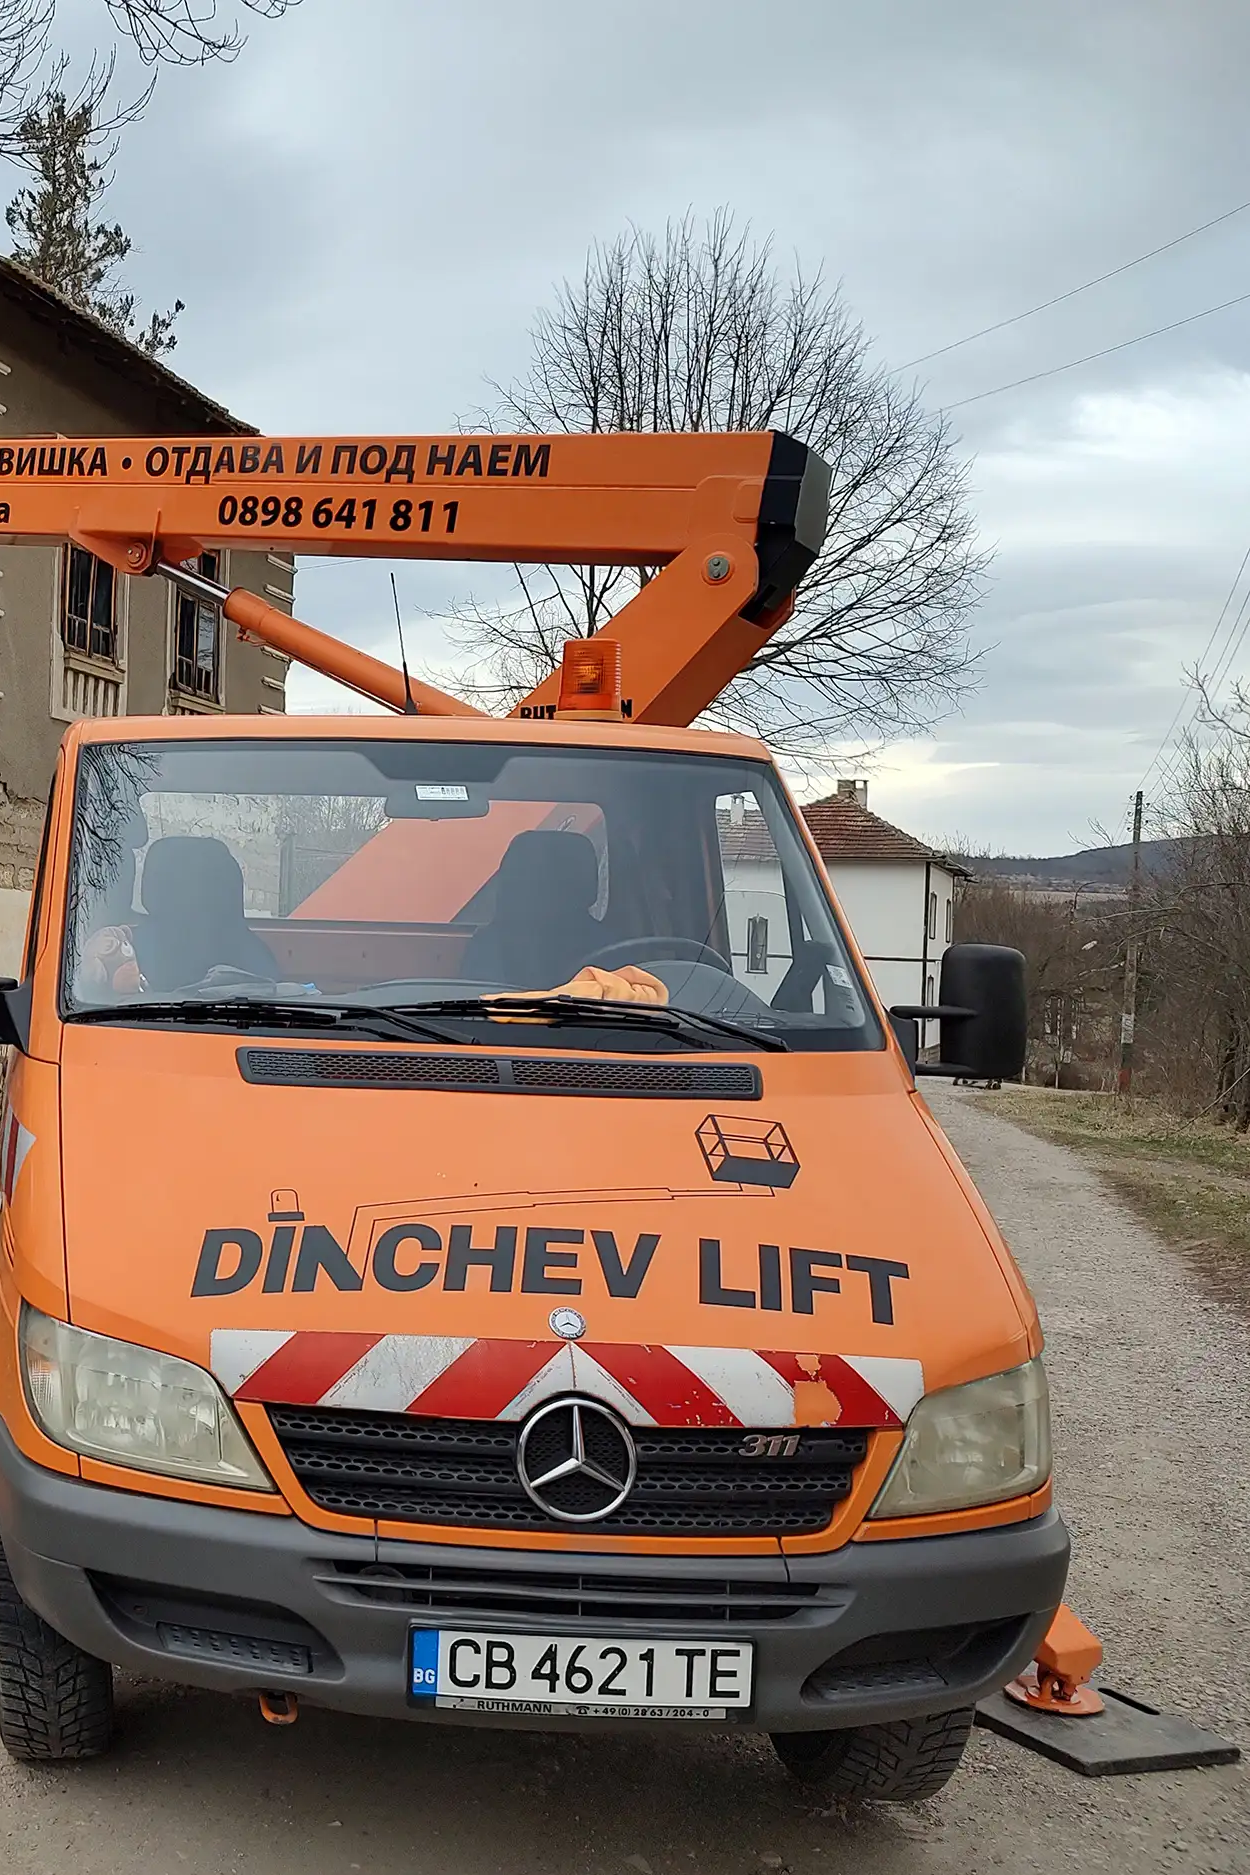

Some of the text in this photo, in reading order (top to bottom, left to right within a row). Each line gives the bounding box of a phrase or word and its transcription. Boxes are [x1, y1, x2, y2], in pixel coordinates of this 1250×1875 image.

[145, 445, 285, 485] ОТДАВА
[295, 445, 323, 475] И
[330, 444, 418, 484] ПОД
[425, 443, 552, 478] НАЕМ
[217, 495, 461, 534] 0898 641 811
[190, 1223, 910, 1326] DINCHEV LIFT
[738, 1434, 801, 1457] 311
[413, 1667, 436, 1684] BG
[530, 1643, 656, 1697] 4621
[476, 1700, 552, 1713] RUTHMANN
